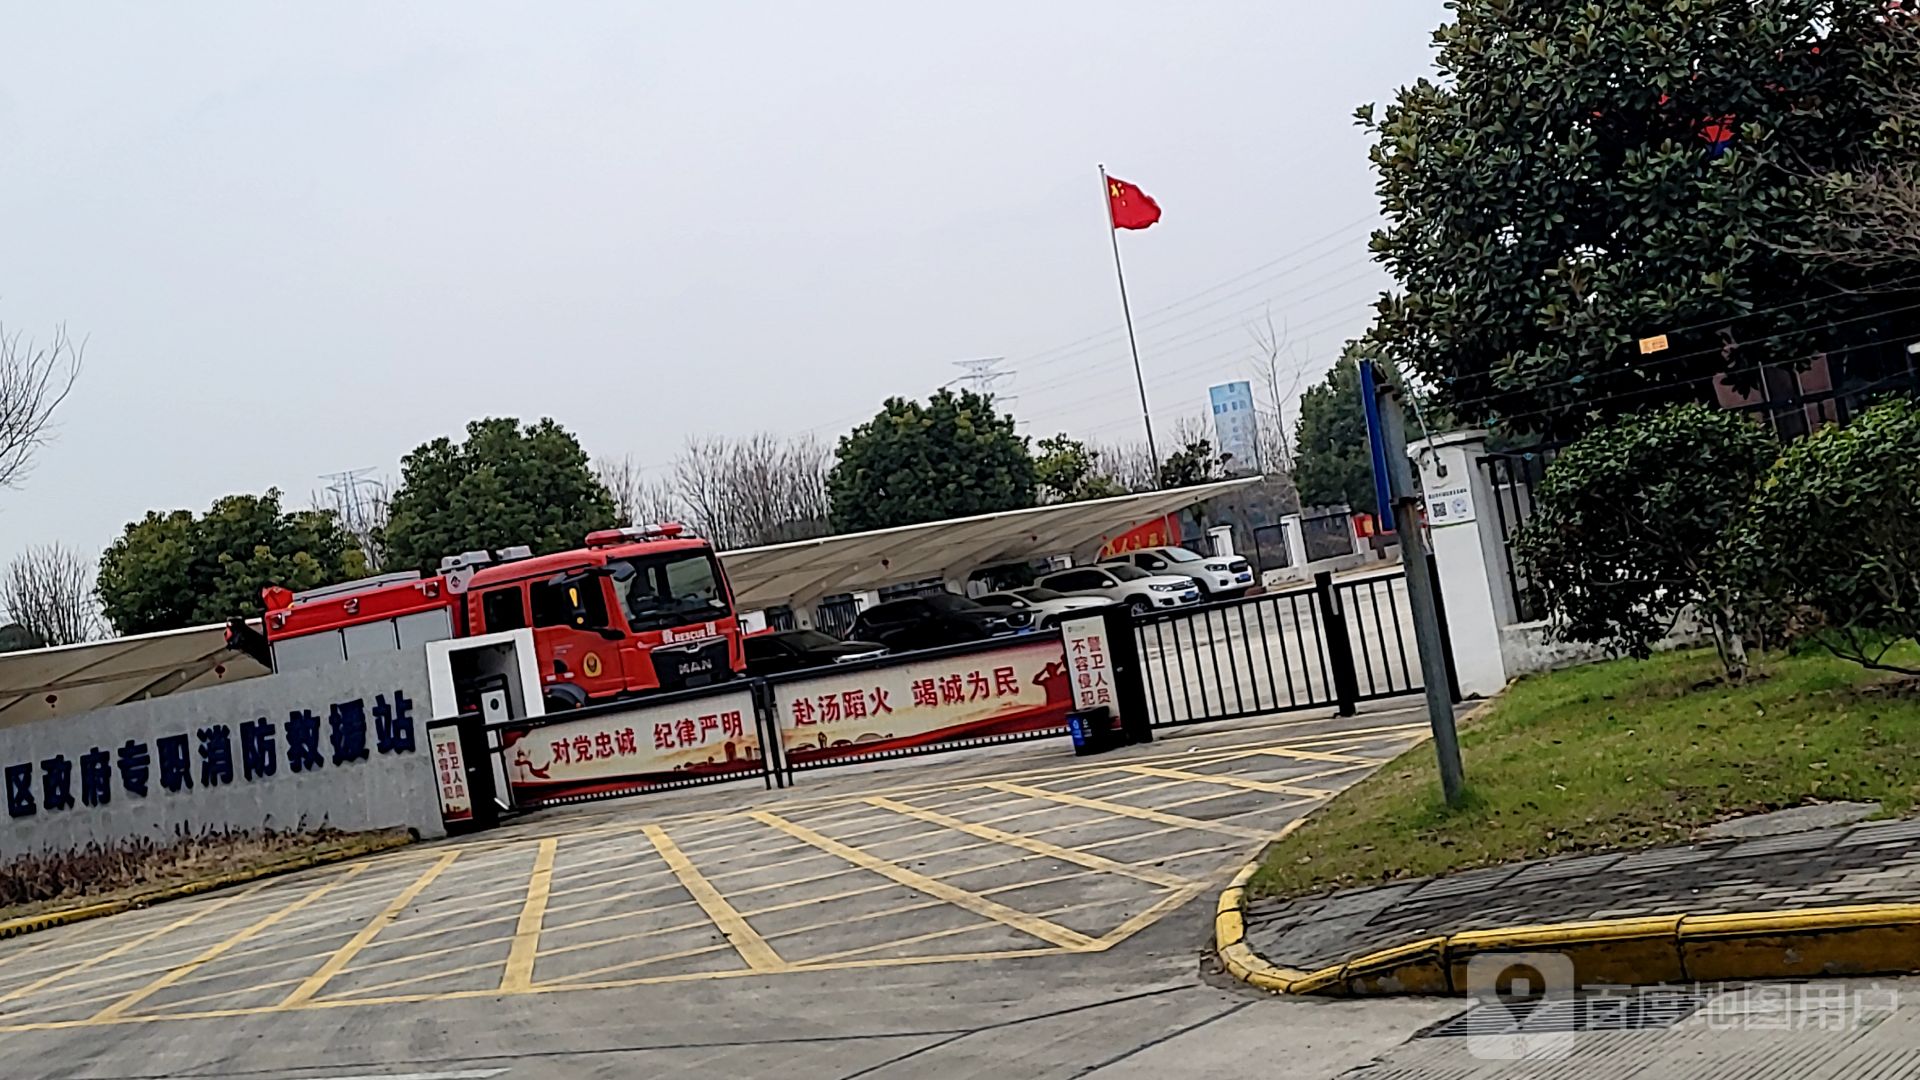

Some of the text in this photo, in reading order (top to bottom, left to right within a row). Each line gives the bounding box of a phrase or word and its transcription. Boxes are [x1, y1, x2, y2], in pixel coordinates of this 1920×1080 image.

[679, 658, 713, 675] MAN
[791, 666, 1021, 728] 赴汤蹈火 竭诚为民
[1071, 638, 1096, 706] 不容侵犯
[4, 689, 417, 818] 区政府专职消防救援站
[550, 710, 744, 766] 对党忠诚 纪律严明
